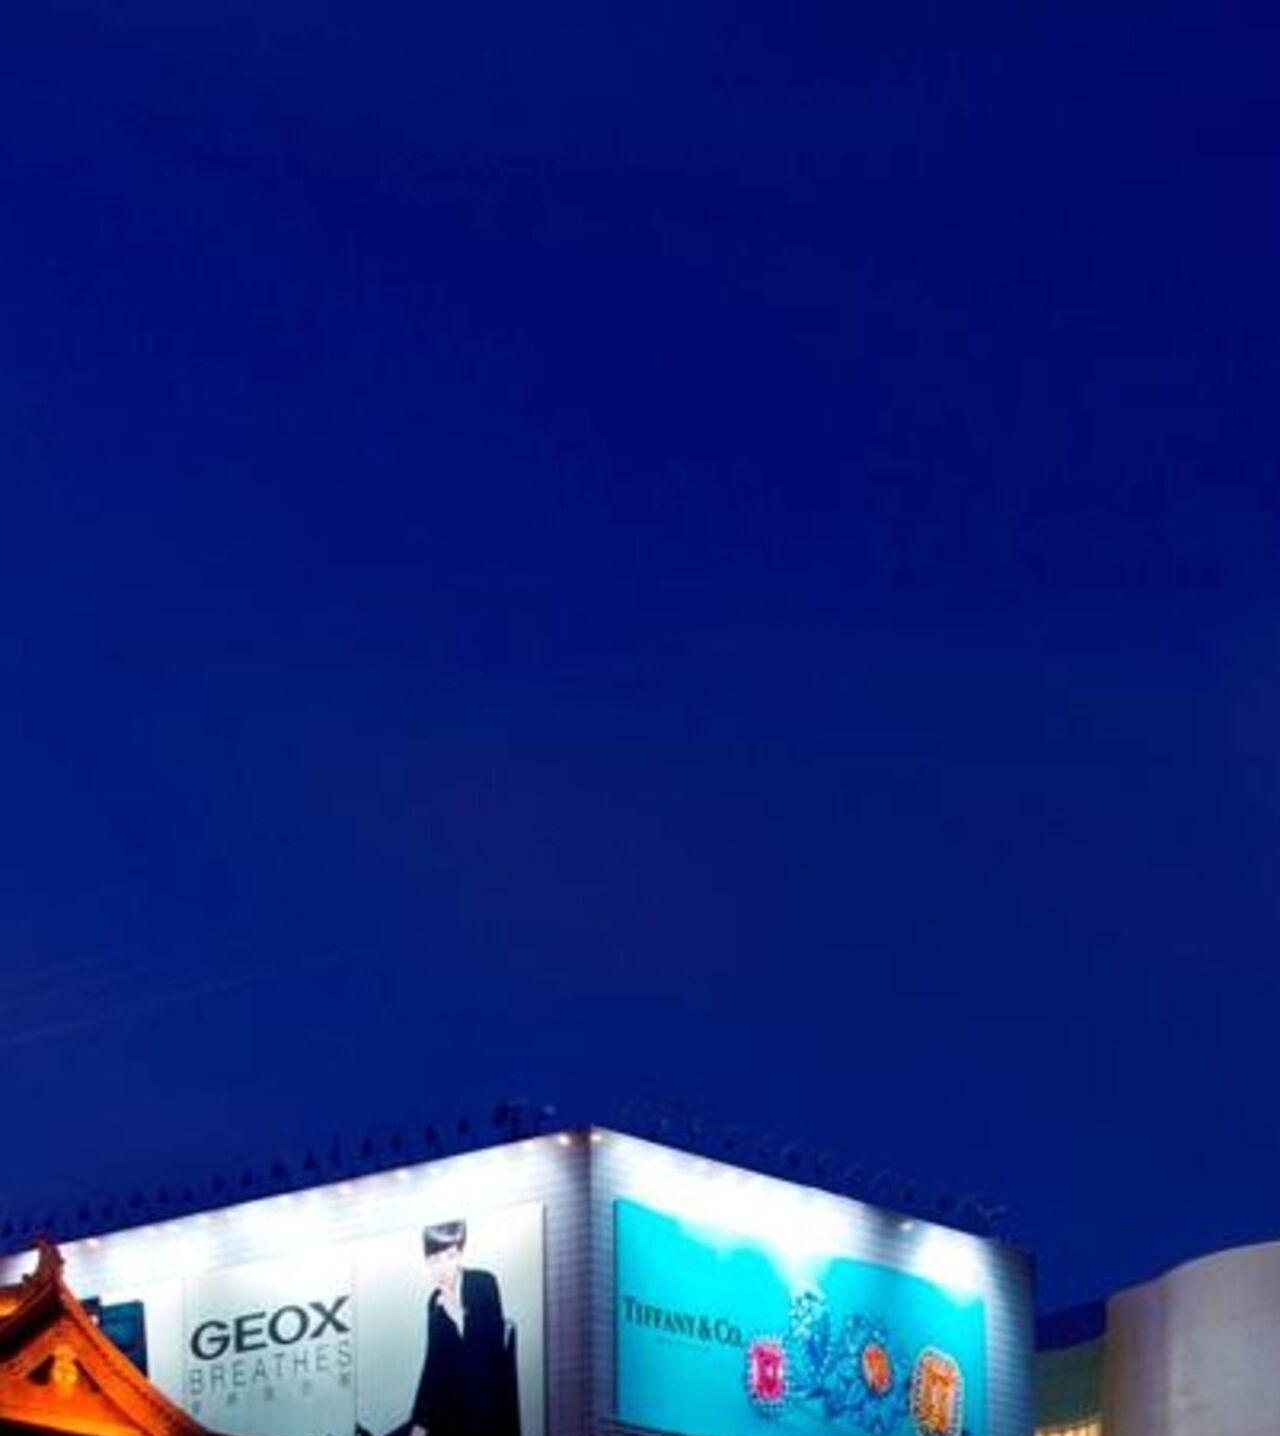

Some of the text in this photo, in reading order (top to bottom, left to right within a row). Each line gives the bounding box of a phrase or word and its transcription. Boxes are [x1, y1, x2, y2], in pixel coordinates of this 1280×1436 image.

[190, 1295, 351, 1361] GEOX
[622, 1296, 696, 1338] TIFFANY
[698, 1314, 713, 1342] &
[190, 1340, 353, 1396] BREATHES
